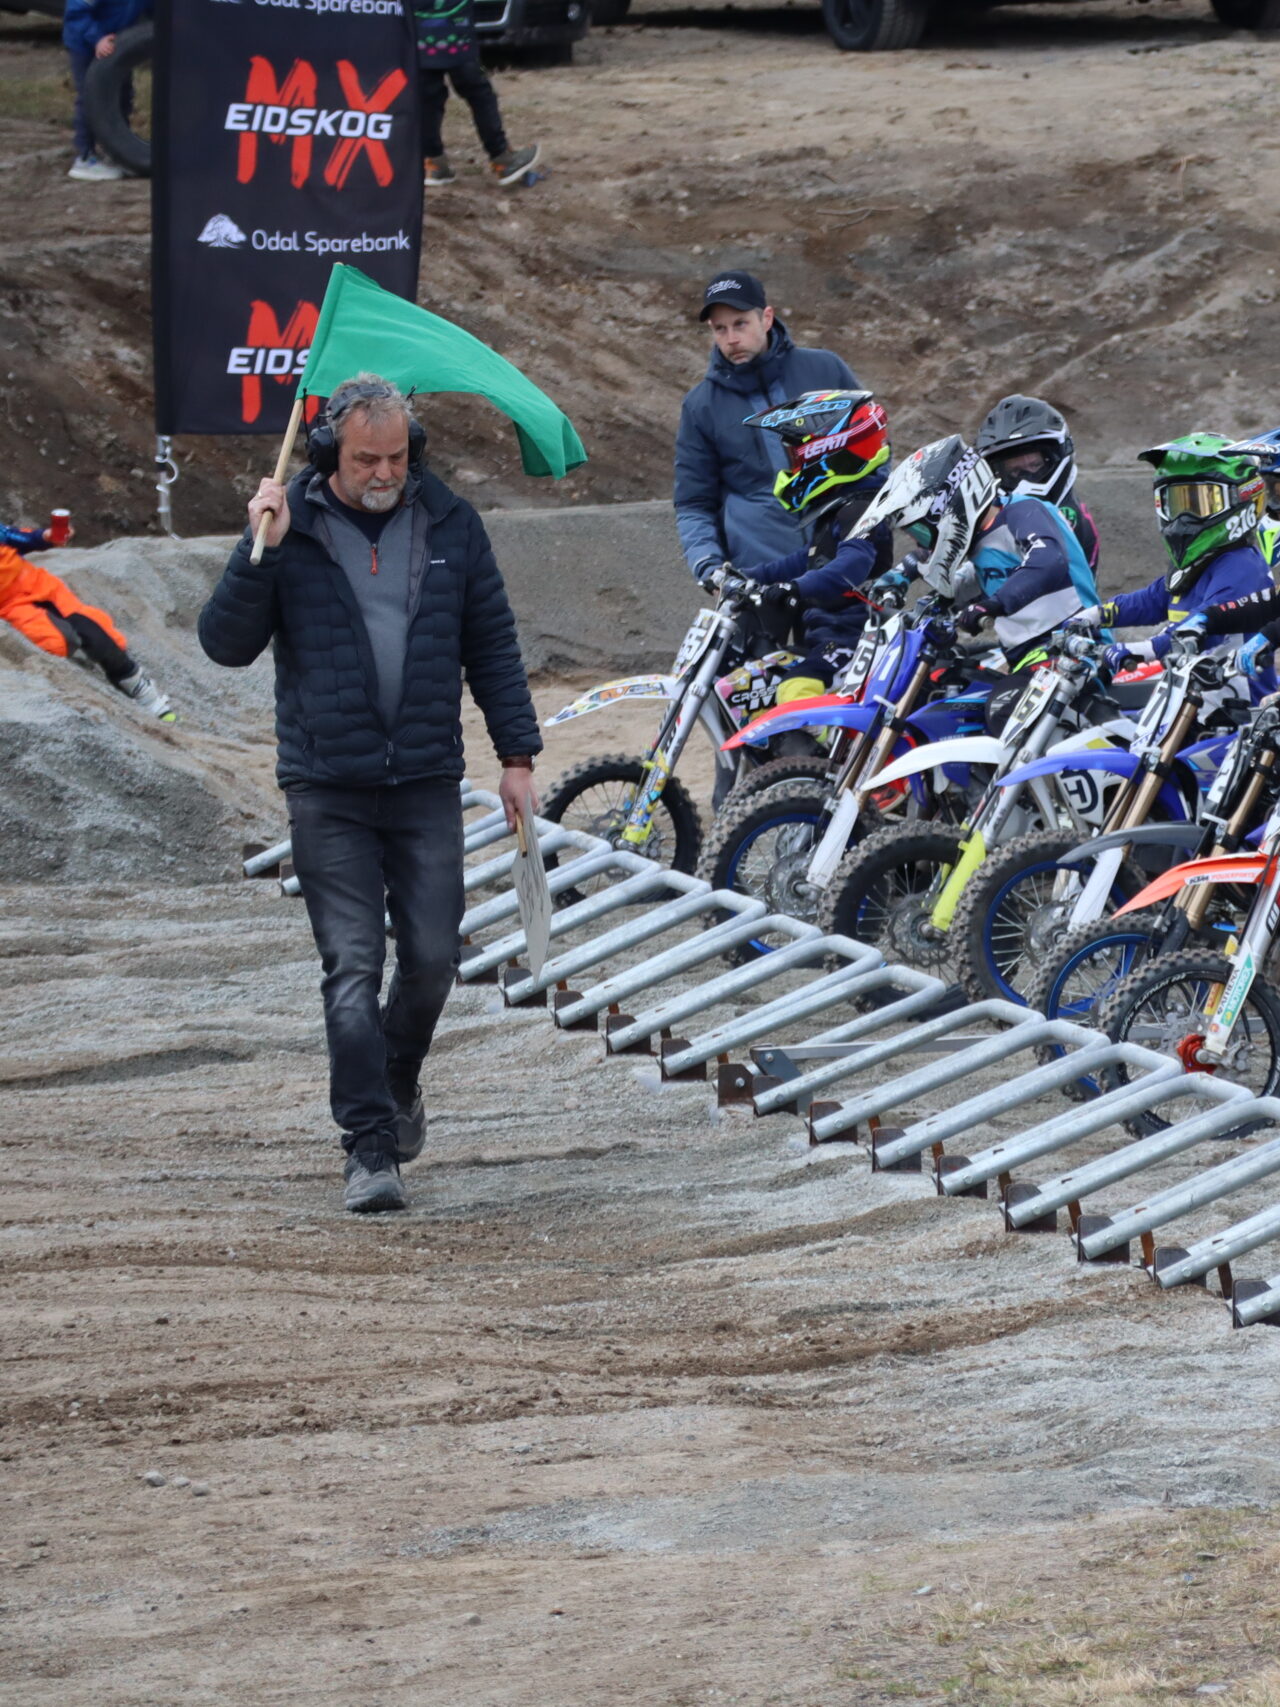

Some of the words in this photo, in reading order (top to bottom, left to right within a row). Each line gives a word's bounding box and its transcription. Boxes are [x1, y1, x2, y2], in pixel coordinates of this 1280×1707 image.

[224, 103, 394, 140] EIDSKOG
[252, 229, 300, 252] Odal
[304, 230, 410, 256] Sparebank
[227, 347, 309, 374] EIDS
[1226, 500, 1258, 541] 216
[1221, 967, 1241, 1009] ATHENA
